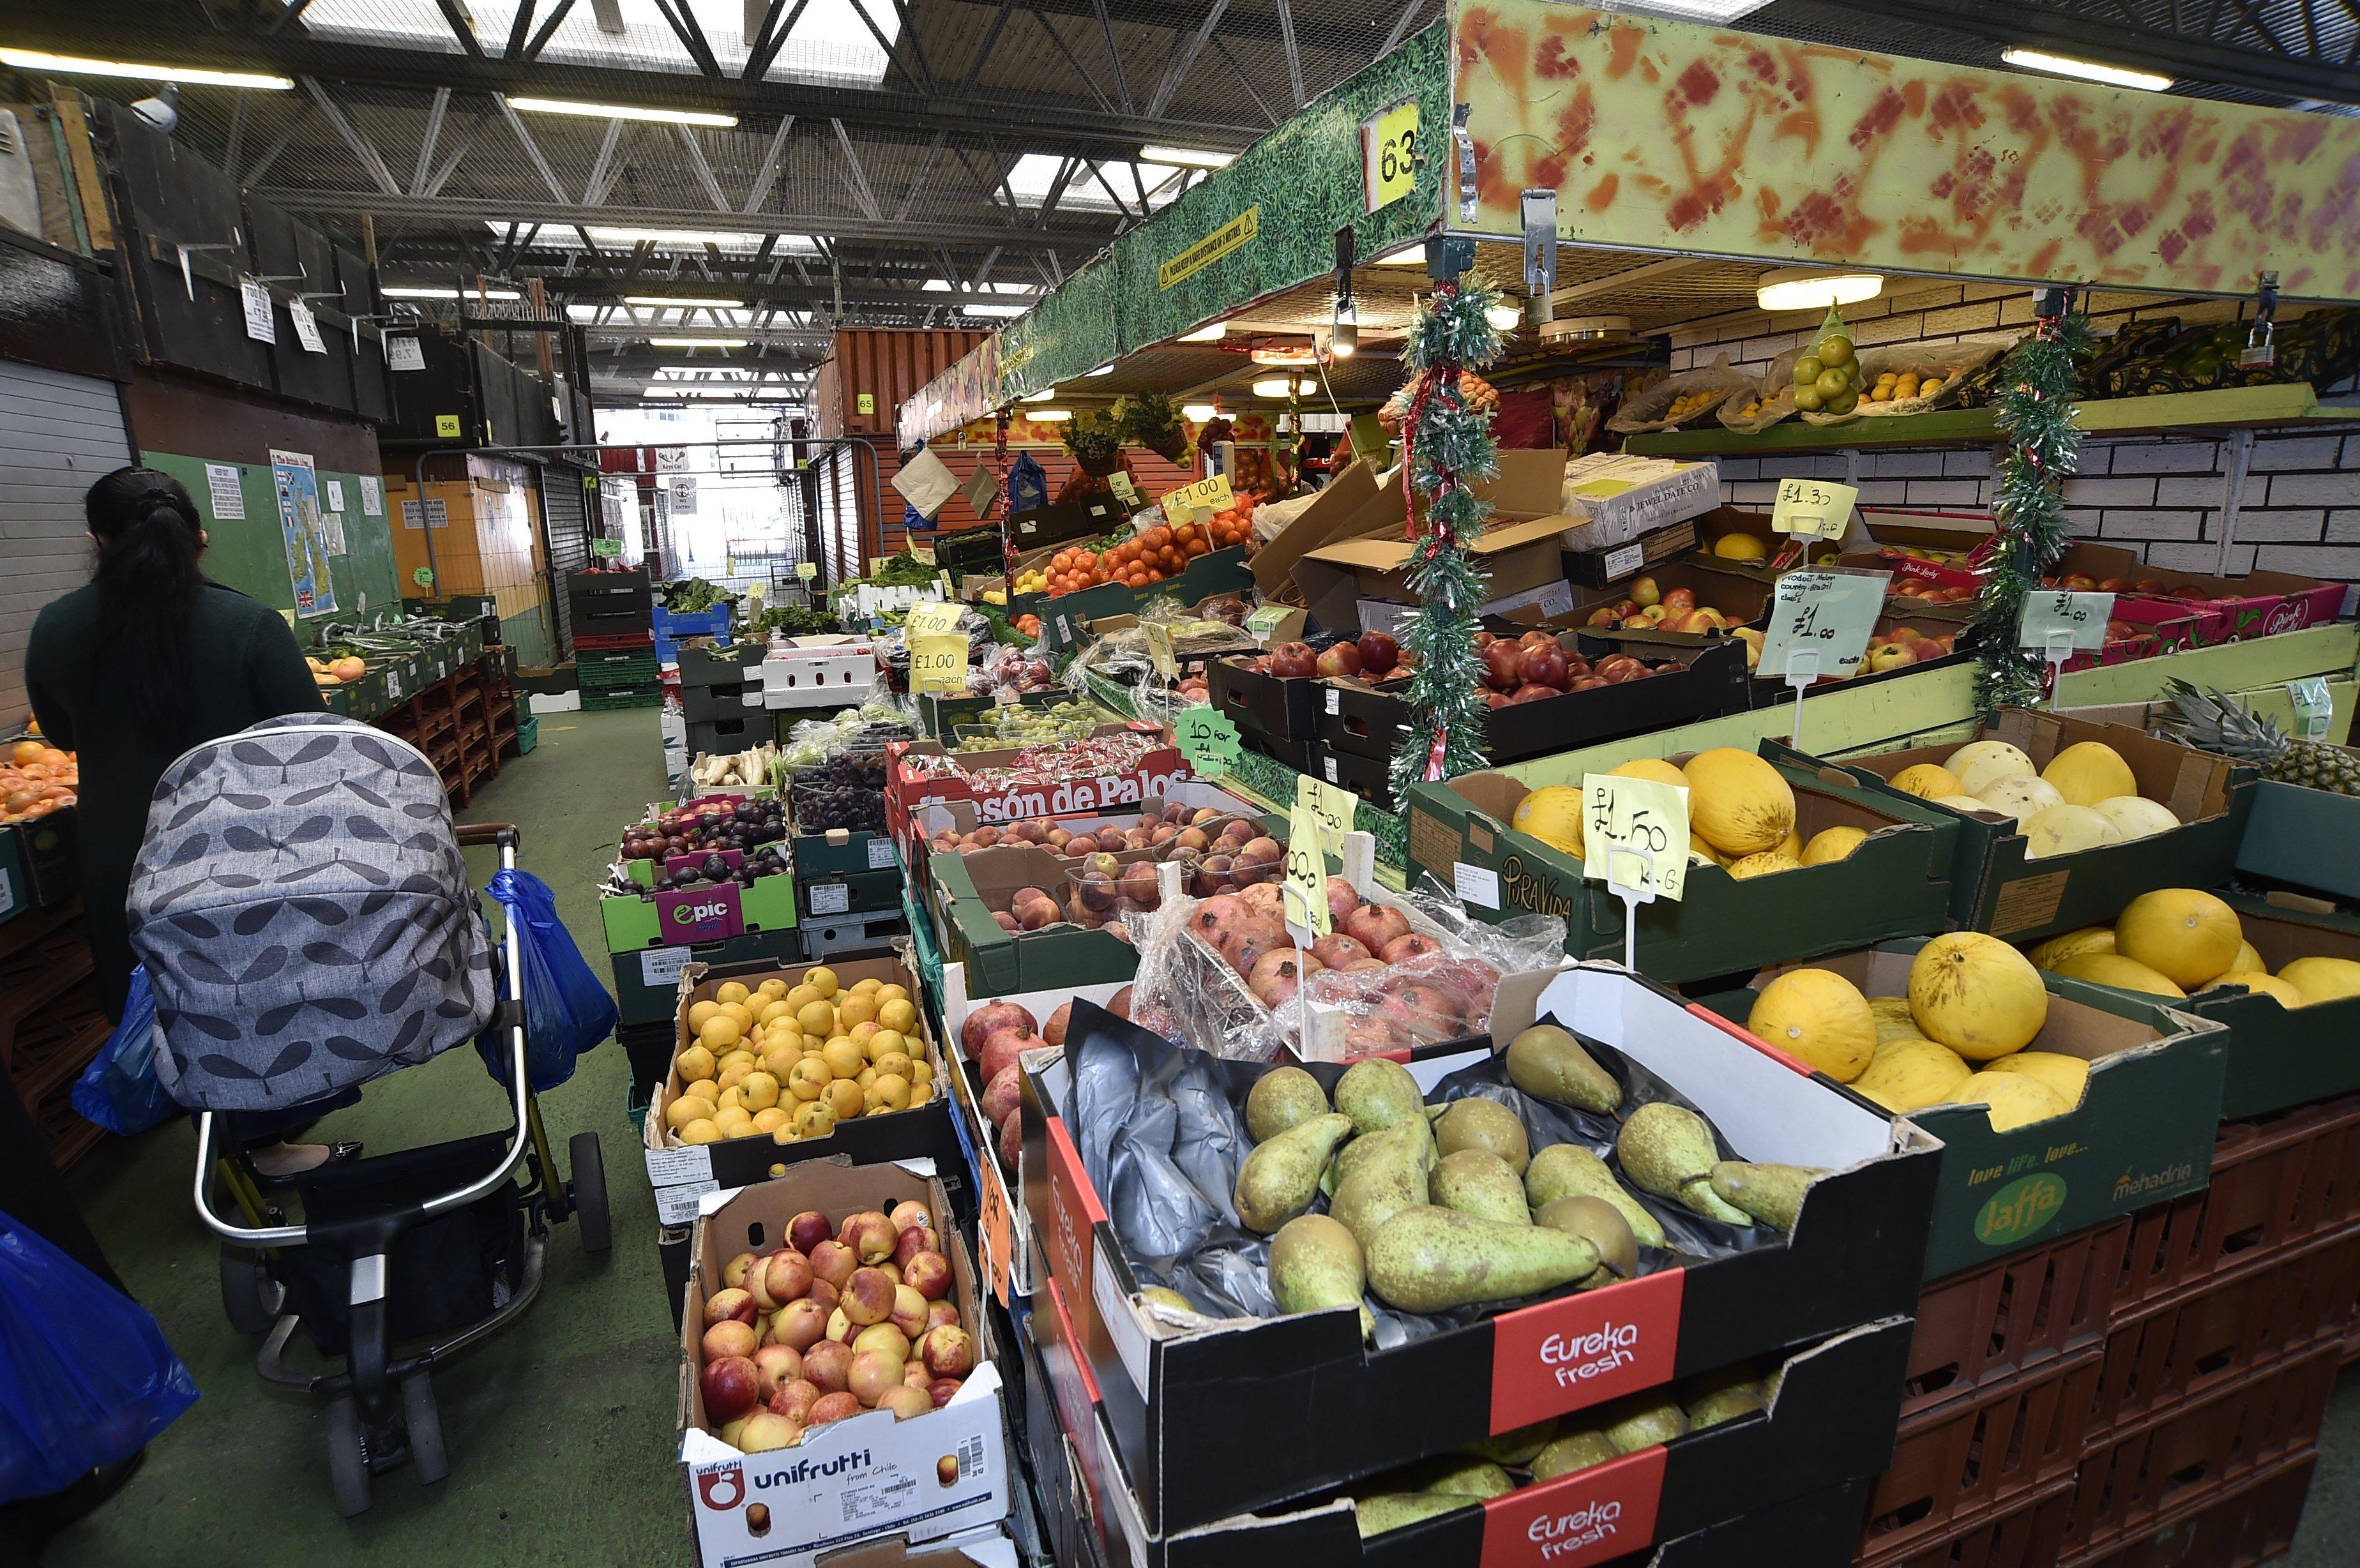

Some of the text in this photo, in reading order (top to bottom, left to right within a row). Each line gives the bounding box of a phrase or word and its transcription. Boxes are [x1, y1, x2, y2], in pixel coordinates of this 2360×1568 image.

[1382, 130, 1416, 182] 63
[1170, 261, 1181, 276] PLEASE
[1200, 239, 1217, 259] DISTANCE
[1217, 234, 1222, 248] OF
[1225, 224, 1241, 243] METRES
[441, 422, 455, 430] 56
[1176, 479, 1218, 506] £1.00
[1210, 494, 1229, 504] each
[1636, 497, 1663, 511] JEWEL
[1664, 486, 1686, 501] DATE
[1687, 481, 1701, 492] CO.
[1783, 483, 1831, 506] £1.30
[1902, 562, 1939, 579] Pink Lady
[1543, 598, 1557, 608] CO.
[2054, 591, 2087, 621] £1.00
[911, 615, 946, 631] £1.00
[1792, 603, 1835, 639] £1.00
[2269, 603, 2301, 633] Pink
[915, 654, 955, 669] £1.00
[1838, 656, 1860, 665] each
[939, 674, 962, 684] each
[1190, 719, 1211, 739] 10
[1052, 780, 1095, 813] de
[1307, 783, 1342, 829] £1.00
[1591, 787, 1667, 852] £1.50
[673, 900, 728, 924] epic
[1967, 1165, 2003, 1187] love
[2112, 1163, 2191, 1201] mehadrin
[1539, 1322, 1638, 1365] Eureka
[1554, 1346, 1635, 1387] fresh
[696, 1459, 742, 1475] unifrutti
[754, 1448, 871, 1489] unifrutti
[847, 1462, 898, 1486] from Chile
[1528, 1500, 1621, 1542] Eureka
[1539, 1521, 1617, 1560] fresh
